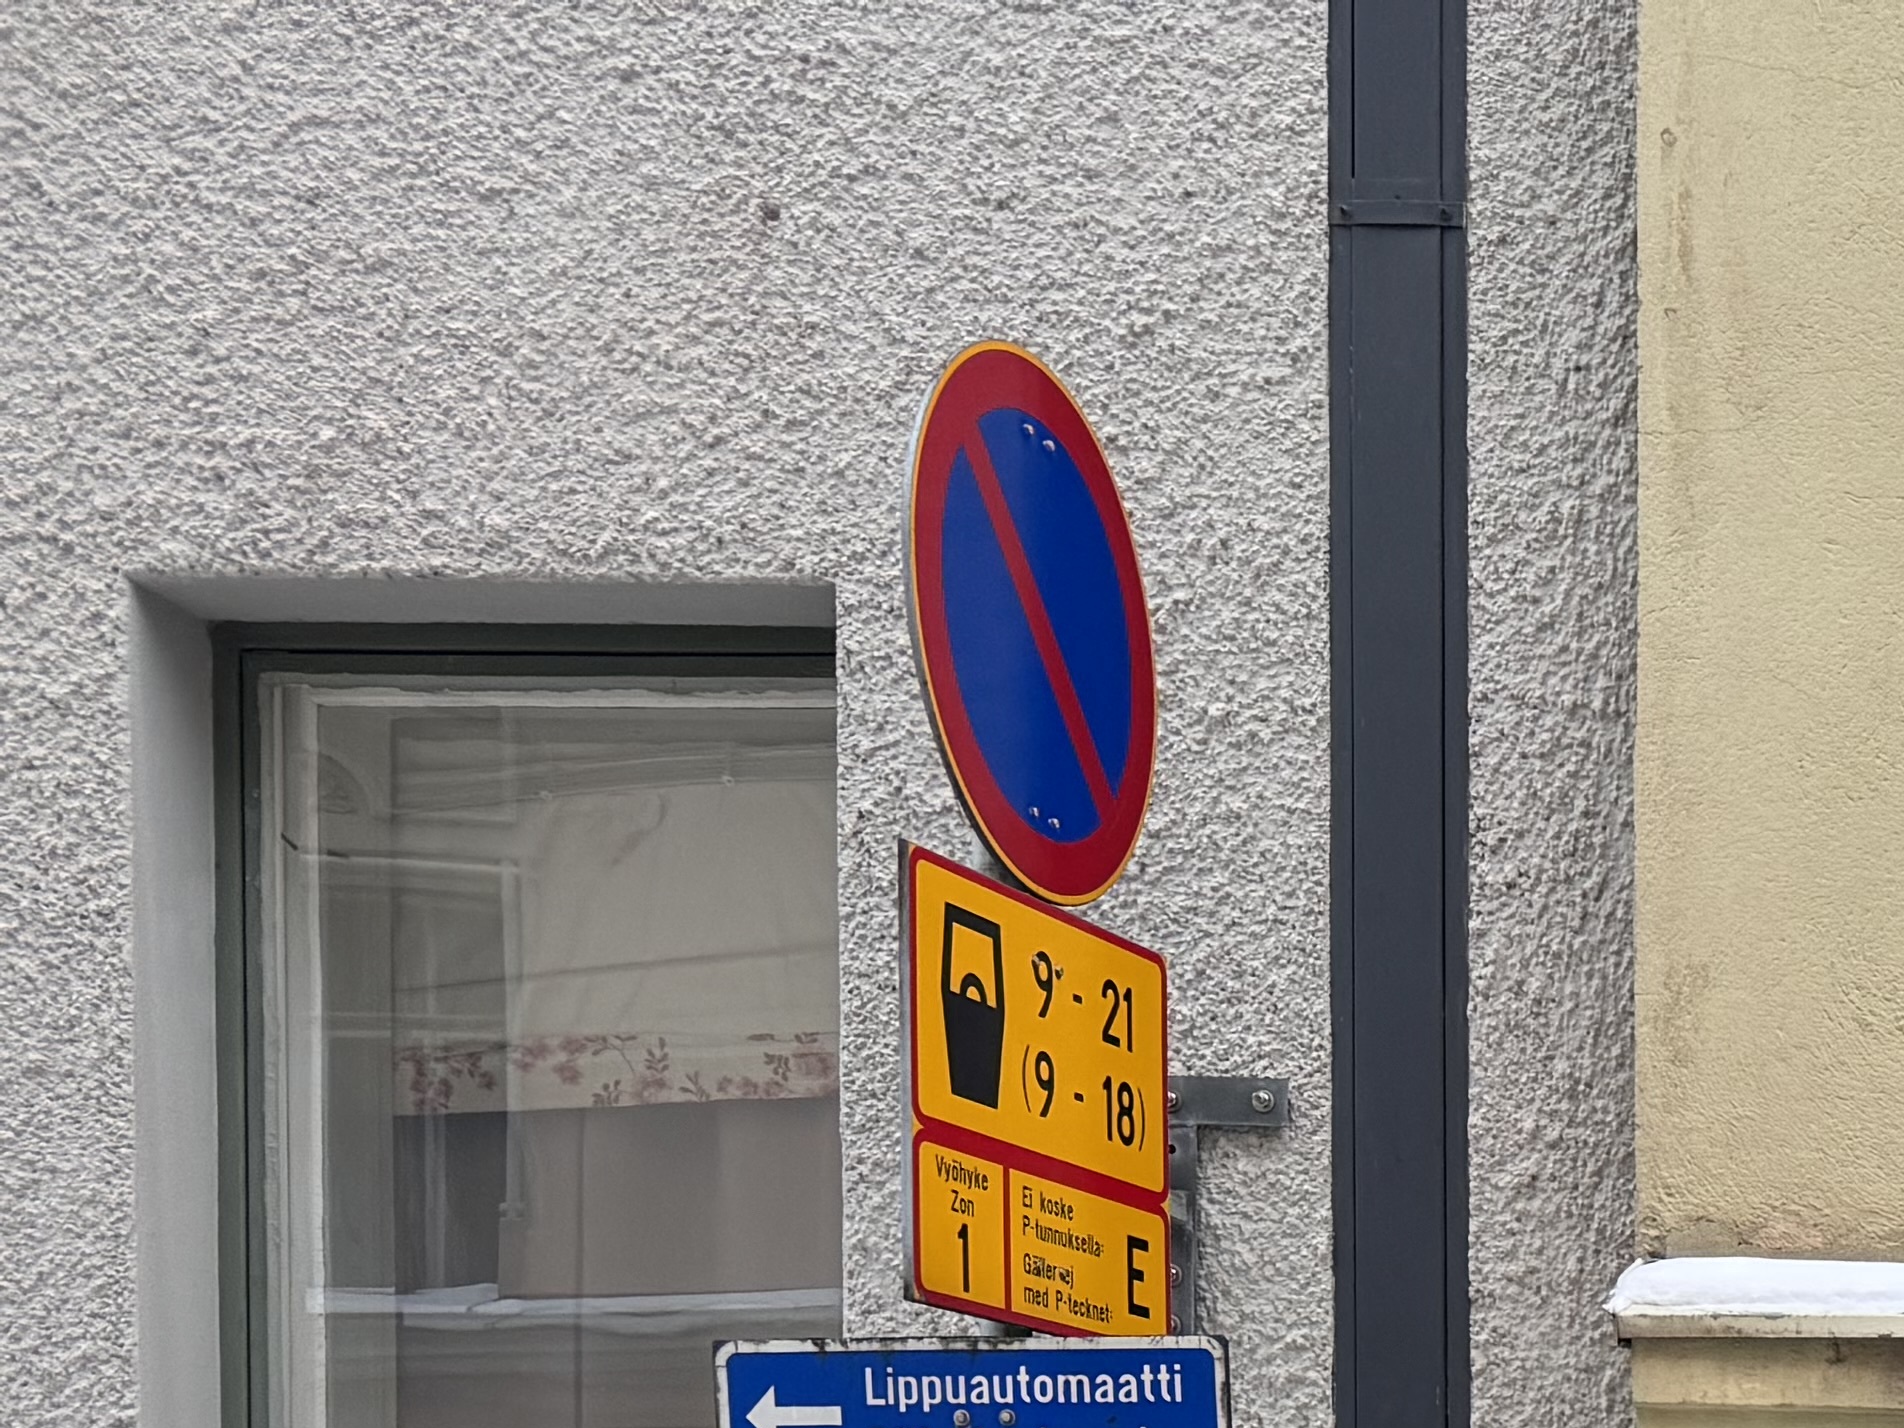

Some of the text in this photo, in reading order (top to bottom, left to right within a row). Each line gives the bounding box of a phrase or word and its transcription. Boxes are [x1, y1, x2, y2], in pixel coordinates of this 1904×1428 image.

[1034, 950, 1056, 1018] 9
[1101, 979, 1134, 1053] 21
[1022, 1044, 1056, 1118] (9
[1103, 1075, 1145, 1151] 18)
[936, 1155, 989, 1191] Vyöhyke
[951, 1190, 975, 1217] Zon
[1022, 1186, 1074, 1222] Ei koske
[957, 1223, 970, 1293] 1
[1127, 1234, 1150, 1319] E
[1024, 1286, 1049, 1308] med
[864, 1364, 1184, 1416] Lippuautomaatti
